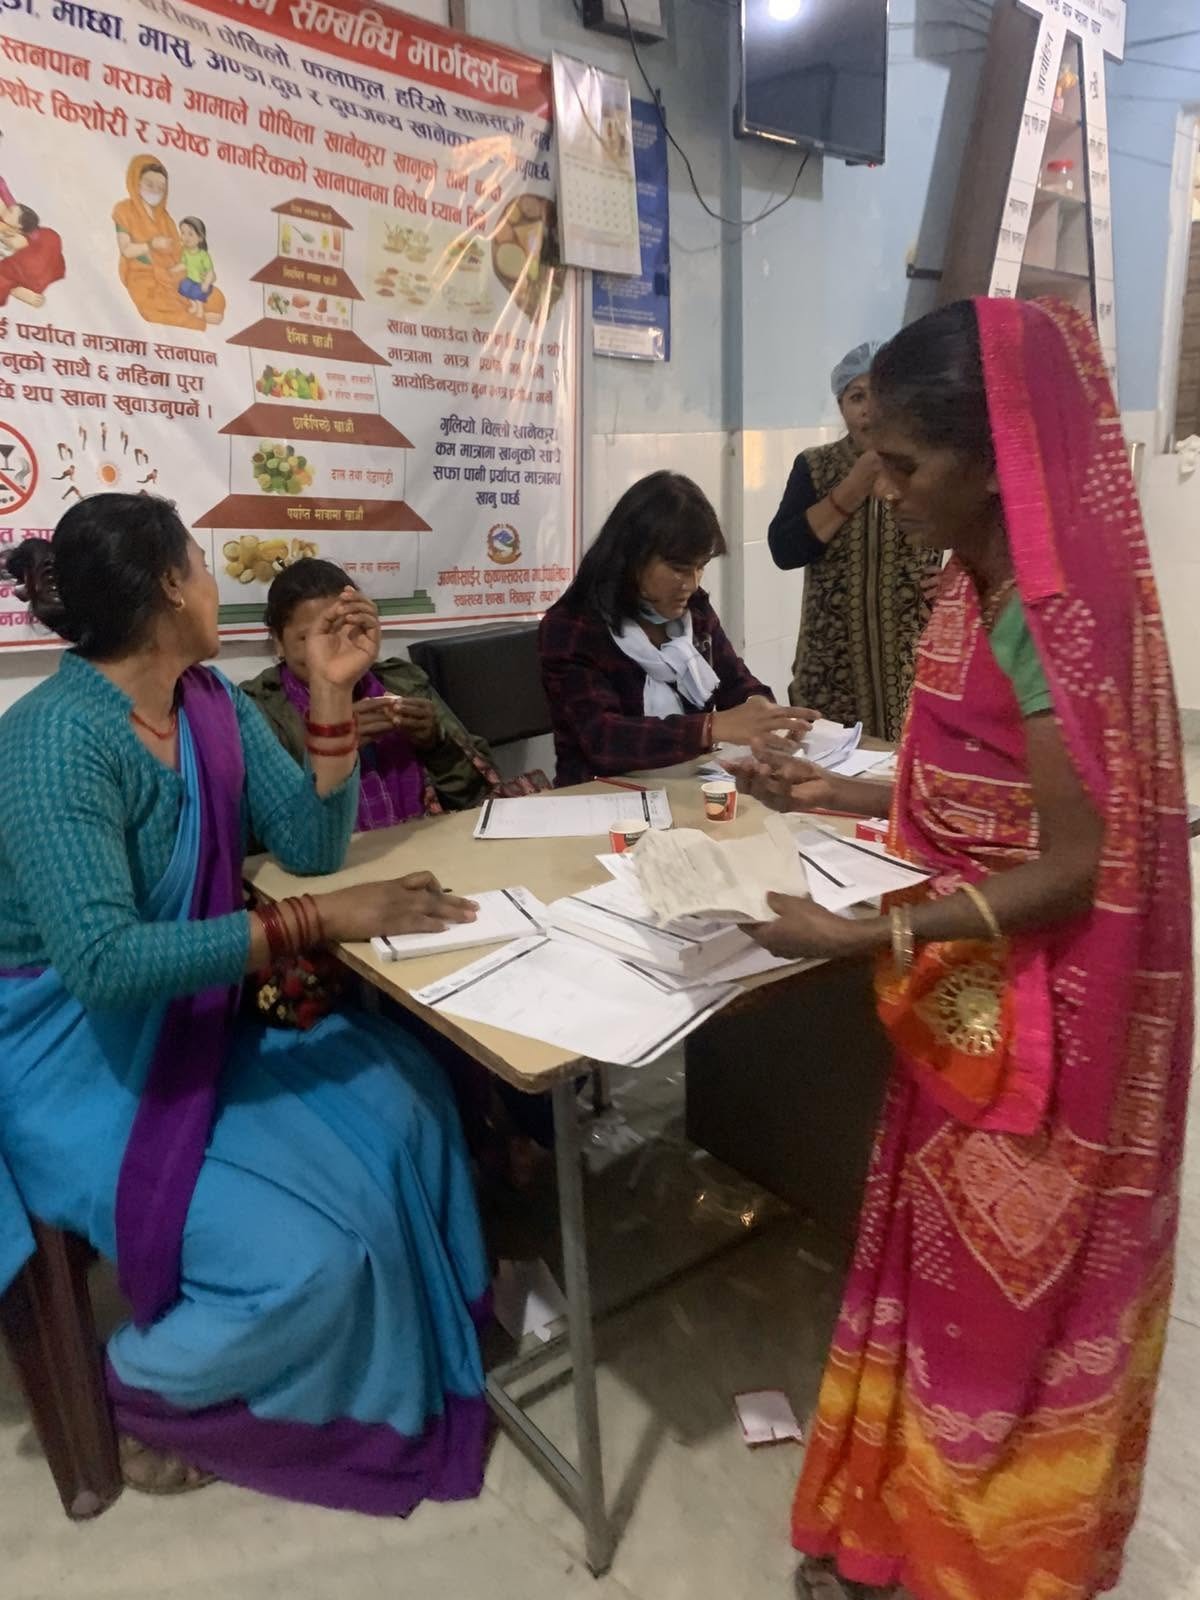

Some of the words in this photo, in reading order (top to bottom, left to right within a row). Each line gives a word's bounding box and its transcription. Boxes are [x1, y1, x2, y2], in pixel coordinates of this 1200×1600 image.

[103, 63, 173, 104] गराउने
[184, 86, 249, 126] आमाले
[51, 89, 128, 137] किशोरी
[136, 118, 150, 144] र
[16, 322, 76, 347] पर्याप्त
[82, 332, 148, 357] मात्रामा
[153, 342, 219, 367] स्तनपान
[52, 356, 91, 379] साथै
[116, 363, 171, 388] महिना
[177, 373, 204, 394] पुरा
[61, 388, 106, 409] खाना
[435, 441, 456, 457] कम
